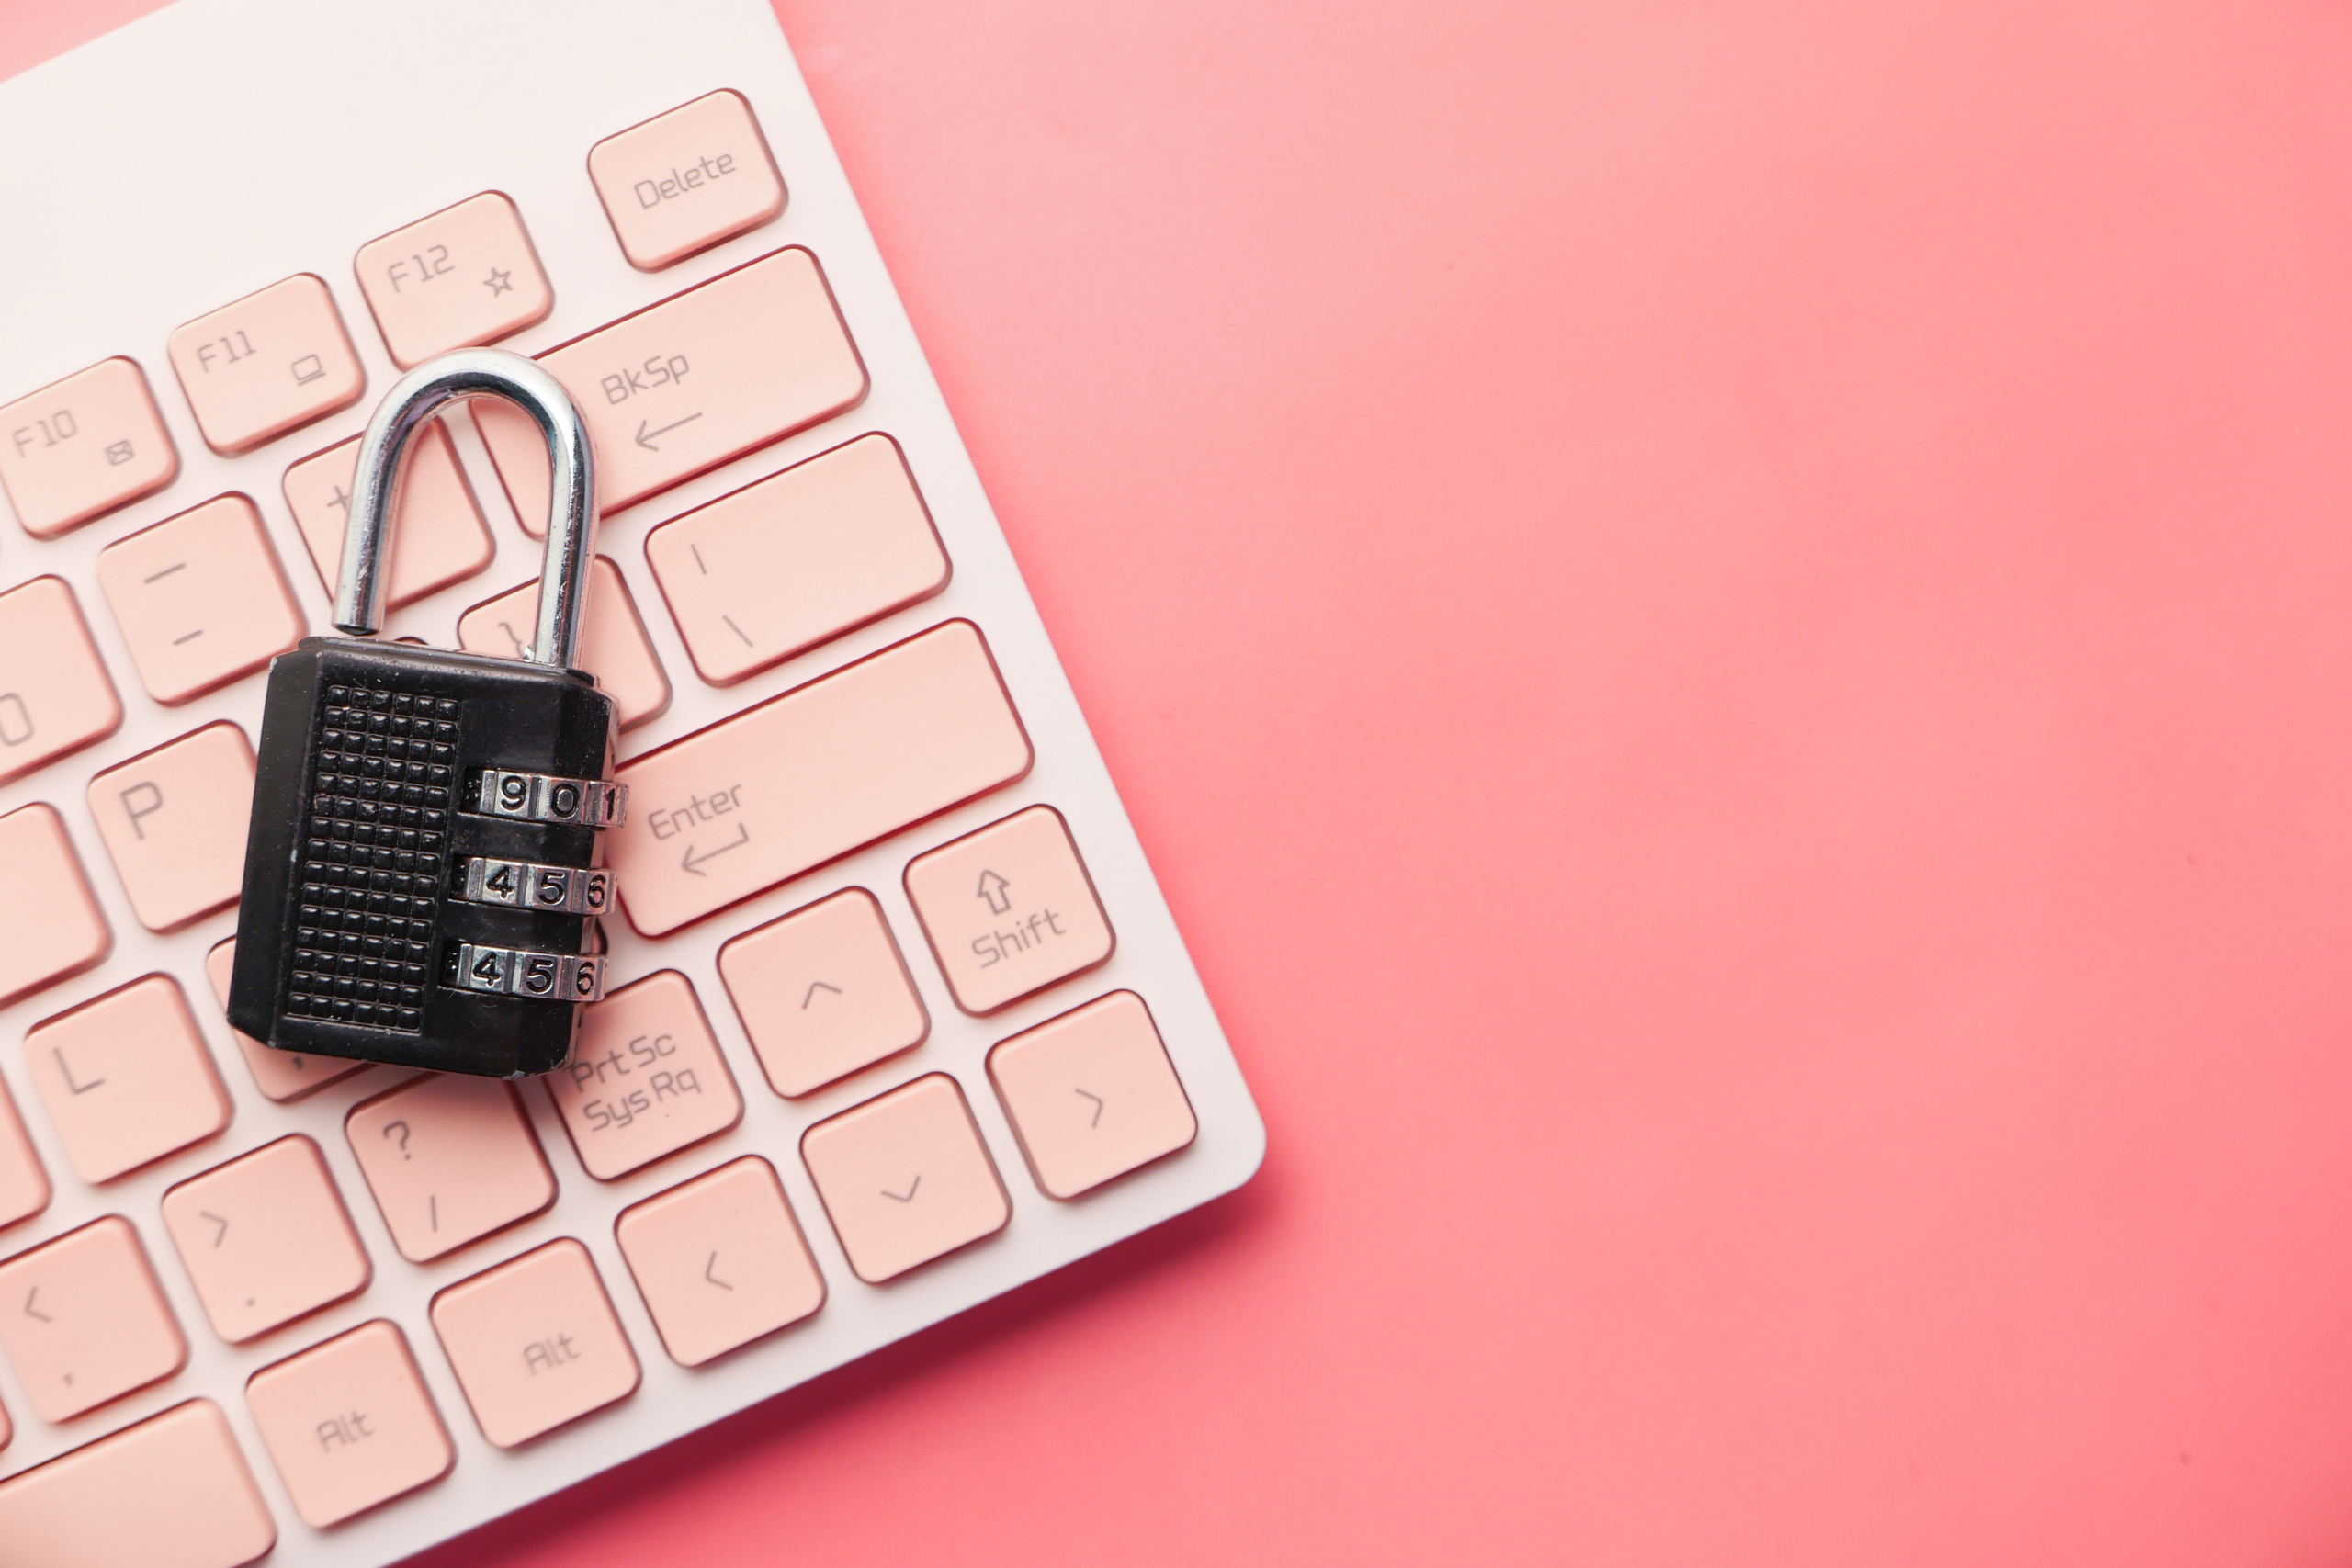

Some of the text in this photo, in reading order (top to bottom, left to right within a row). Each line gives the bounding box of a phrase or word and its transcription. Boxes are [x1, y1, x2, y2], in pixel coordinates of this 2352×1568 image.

[634, 154, 736, 209] Delete
[388, 244, 455, 293] F12
[197, 330, 257, 373] F11
[601, 355, 689, 405] BkSp
[12, 410, 77, 457] F10
[119, 782, 164, 840] P
[647, 784, 742, 841] Enter
[971, 908, 1066, 968] Shift
[52, 1047, 105, 1095] L
[571, 1034, 676, 1093] Prt Sc
[583, 1069, 701, 1132] Sys Rq
[383, 1120, 411, 1161] ?
[523, 1334, 581, 1375] Alt
[316, 1411, 374, 1452] Alt
